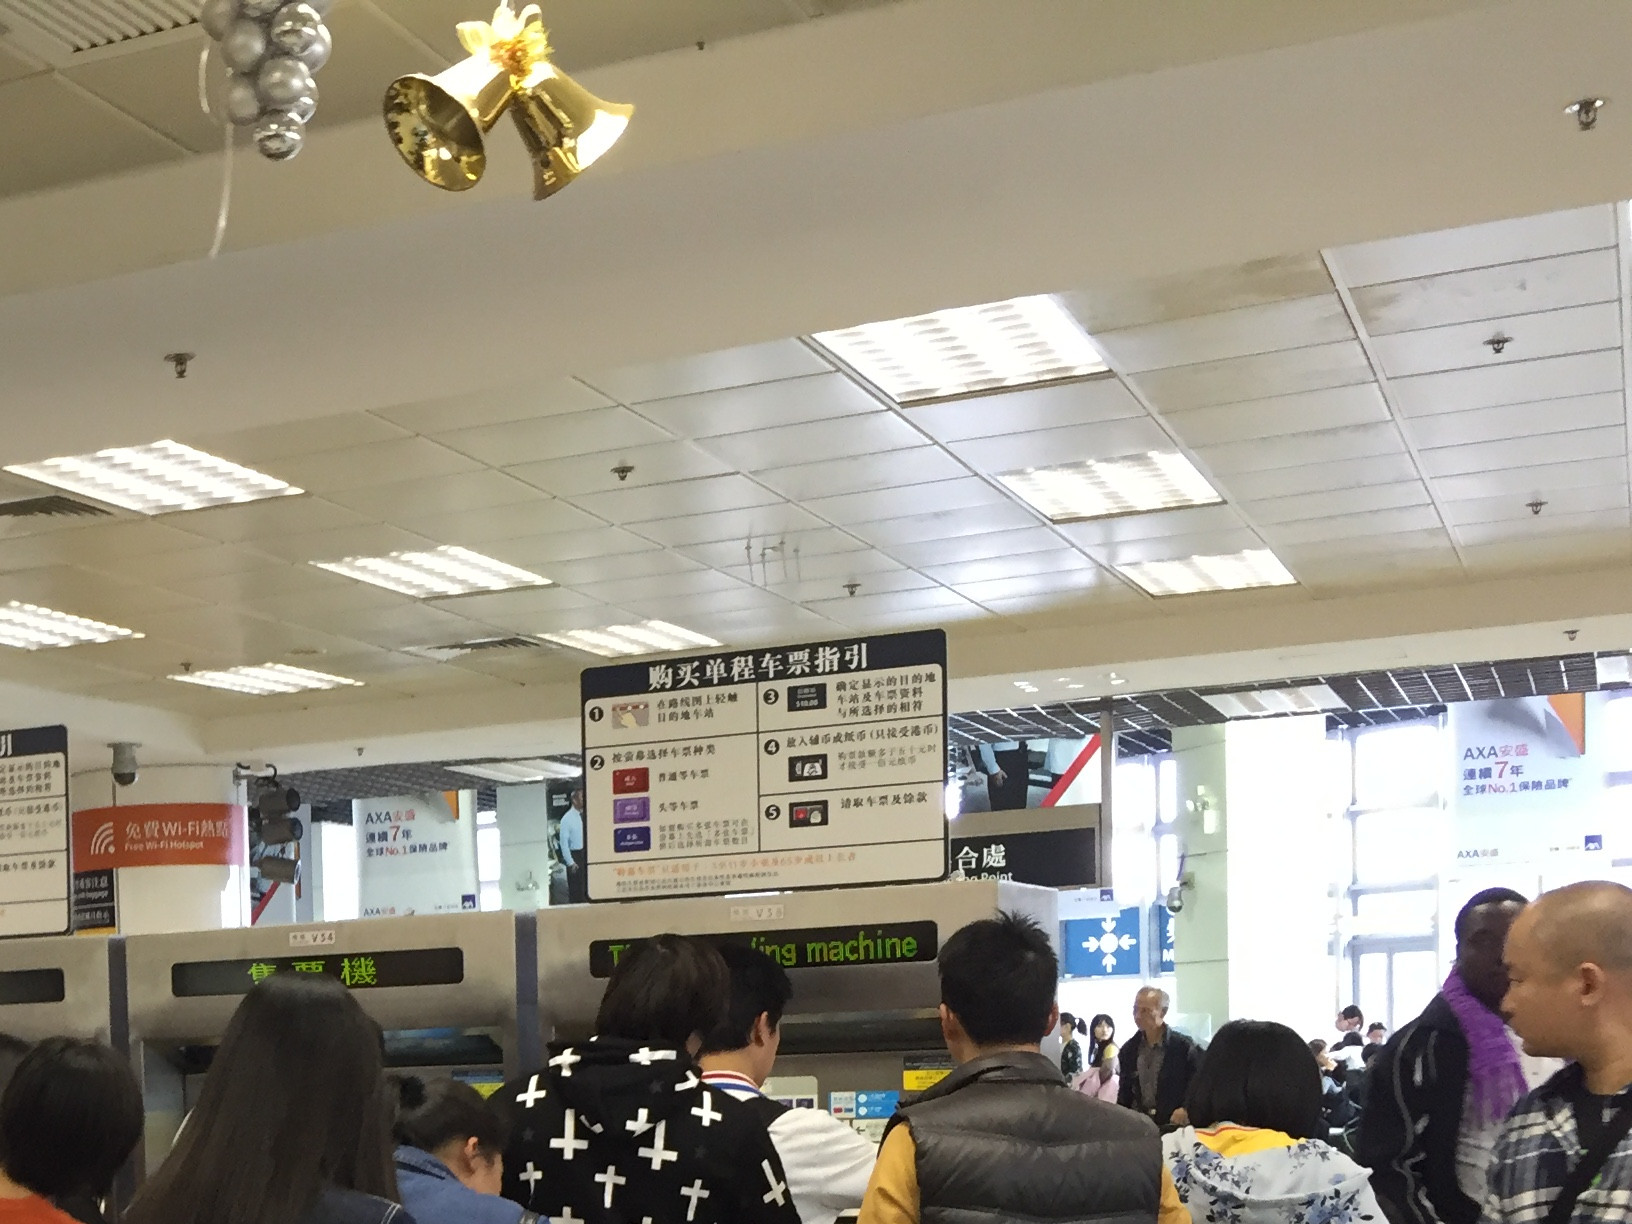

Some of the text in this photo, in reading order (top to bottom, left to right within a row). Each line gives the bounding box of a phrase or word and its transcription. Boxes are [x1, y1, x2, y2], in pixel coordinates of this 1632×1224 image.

[648, 643, 868, 691] 购买单程车票指引
[1463, 743, 1529, 760] AXA安盛
[1463, 761, 1524, 781] 連續7年
[366, 825, 413, 843] 連續7年
[125, 842, 144, 851] Free
[145, 841, 169, 850] Wi-Fi
[806, 930, 918, 963] machine
